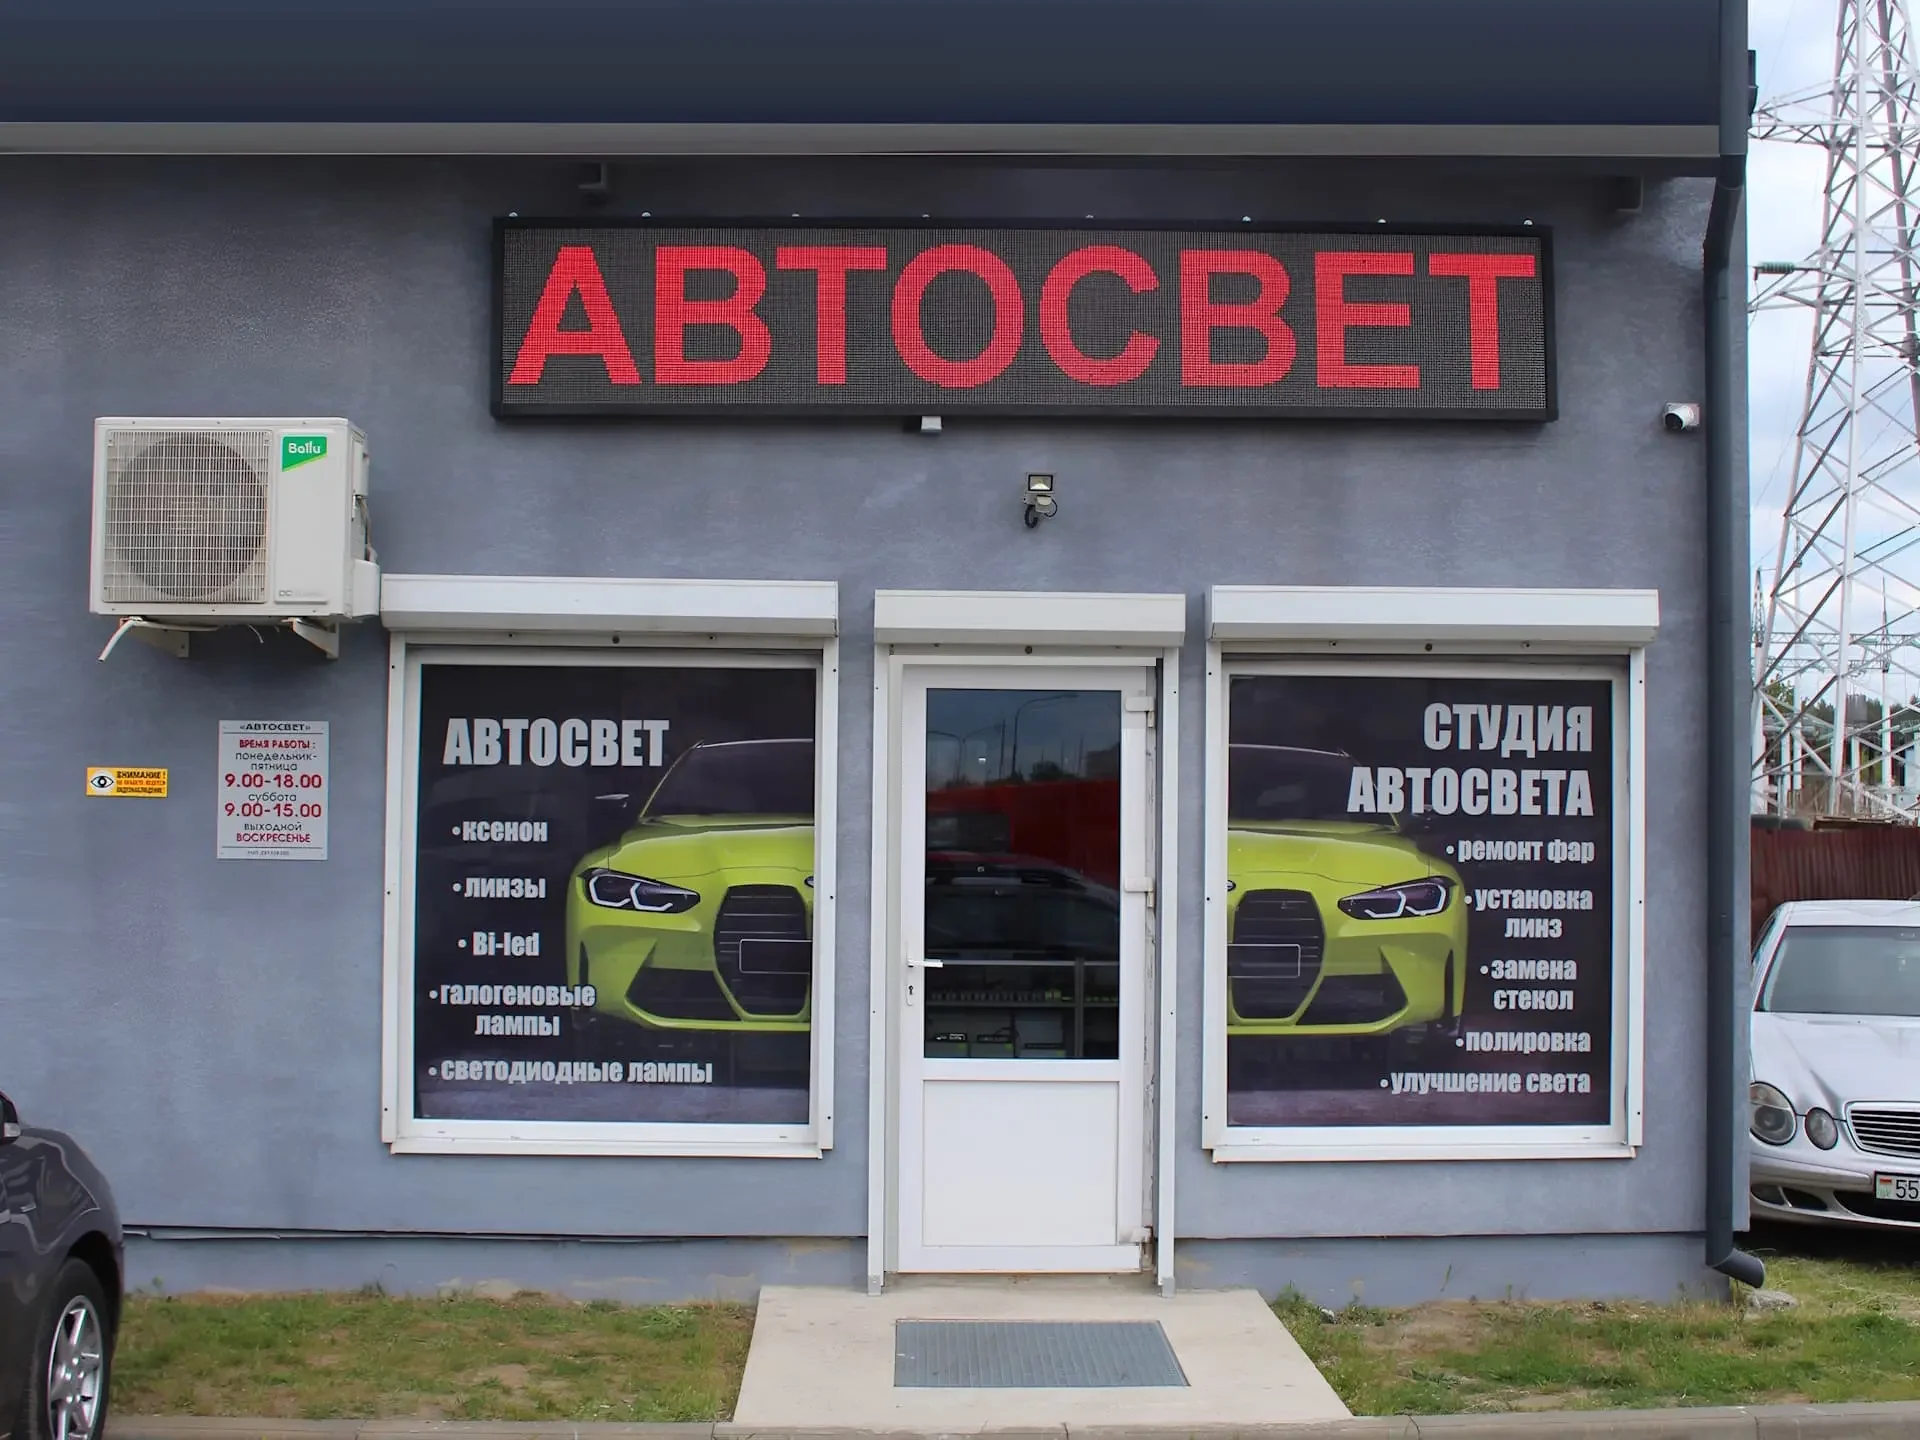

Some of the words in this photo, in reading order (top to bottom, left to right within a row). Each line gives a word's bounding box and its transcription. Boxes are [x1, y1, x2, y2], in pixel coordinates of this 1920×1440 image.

[507, 244, 1535, 389] АВТОСВЕТ
[288, 441, 321, 454] Ballu
[1424, 703, 1593, 758] СТУДИЯ
[239, 740, 270, 749] ВРЕМЯ
[443, 718, 670, 767] АВТОСВЕТ
[251, 763, 298, 772] пятница
[224, 773, 322, 788] 9.00-18.00
[1347, 766, 1594, 816] АВТОСВЕТА
[248, 792, 297, 803] суббота
[224, 803, 322, 818] 9.00-15.00
[236, 833, 311, 843] ВОСКРЕСЕНЬЕ
[462, 821, 548, 842] ксенон
[1458, 840, 1543, 862] ремонт
[1547, 838, 1595, 863] фар
[464, 877, 546, 898] линзы
[1475, 889, 1593, 911] установка
[1505, 918, 1563, 938] линз
[473, 932, 540, 957] Bi-led
[1491, 960, 1577, 980] замена
[440, 984, 596, 1007] галогеновые
[1494, 990, 1574, 1010] стекол
[475, 1015, 560, 1036] лампы
[1466, 1032, 1591, 1053] полировка
[440, 1060, 623, 1084] светодиодные
[627, 1062, 713, 1083] лампы
[1391, 1072, 1521, 1094] улучшение
[1526, 1073, 1591, 1093] света
